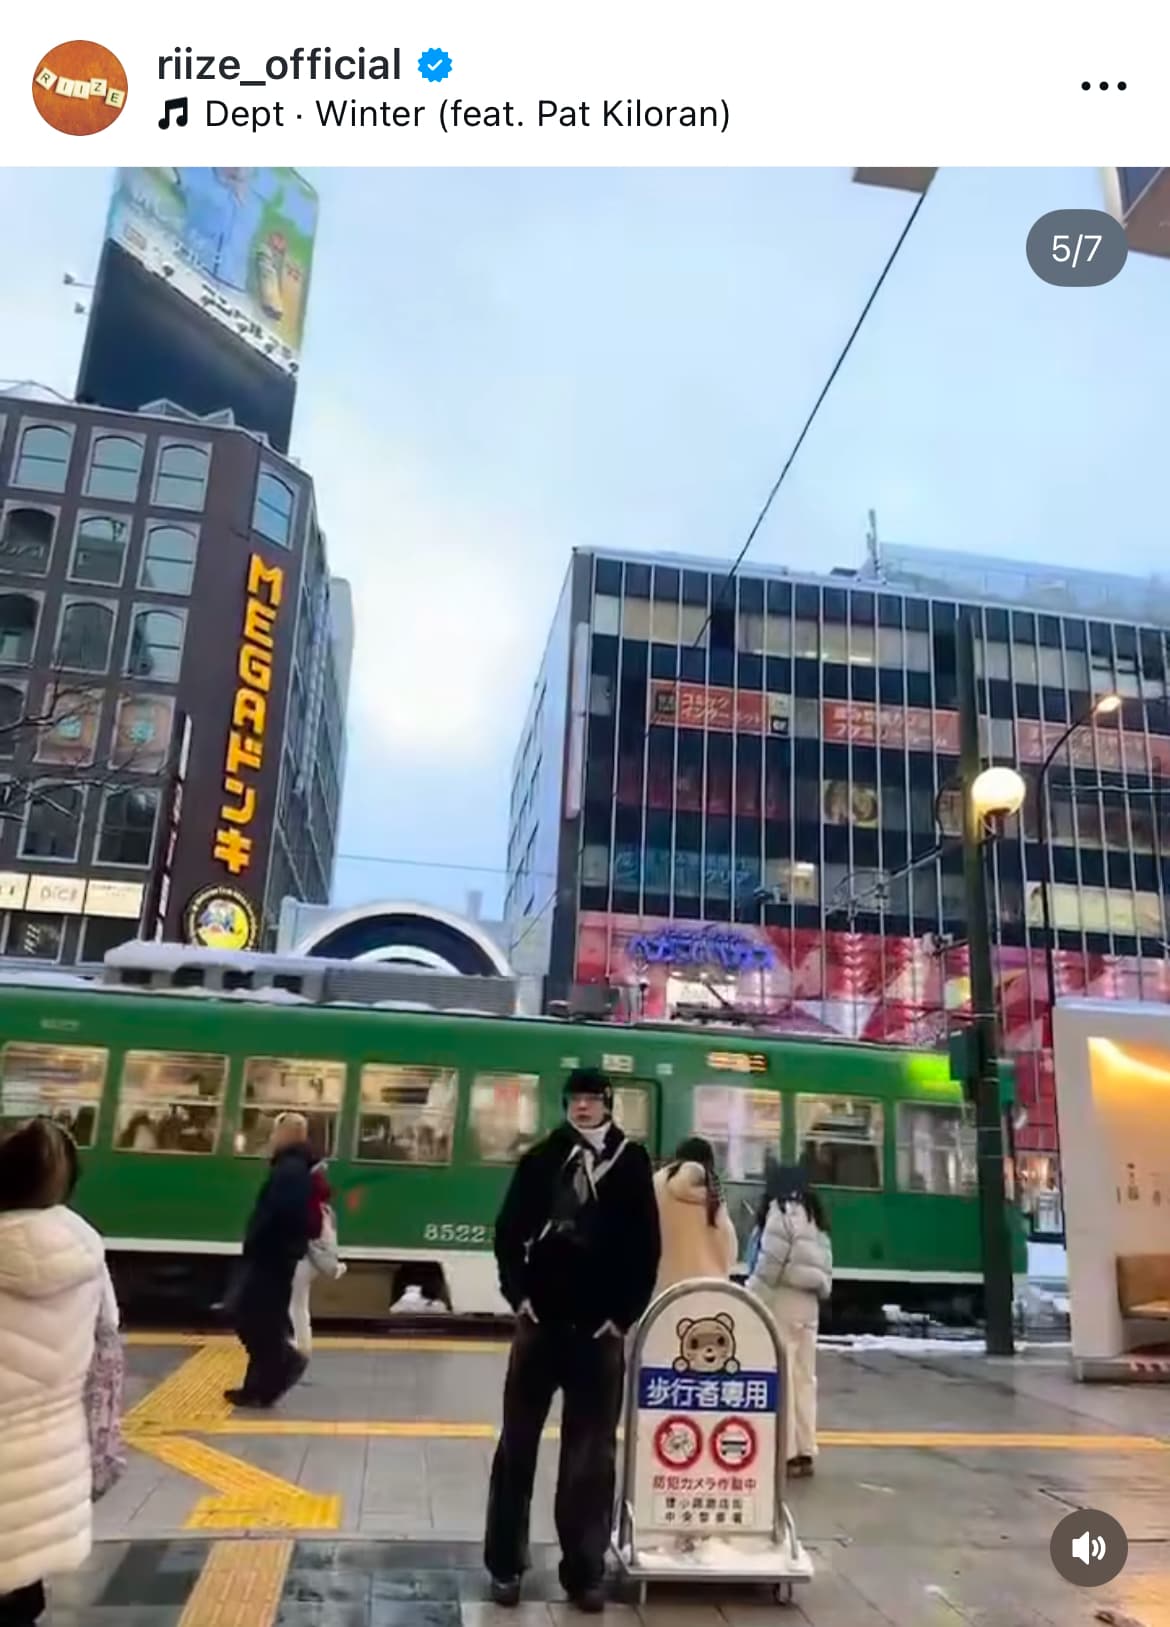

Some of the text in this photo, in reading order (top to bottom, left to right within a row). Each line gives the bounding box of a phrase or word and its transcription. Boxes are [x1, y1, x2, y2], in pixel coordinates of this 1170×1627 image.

[424, 1223, 486, 1243] 8522
[646, 1377, 769, 1409] 歩行者専用
